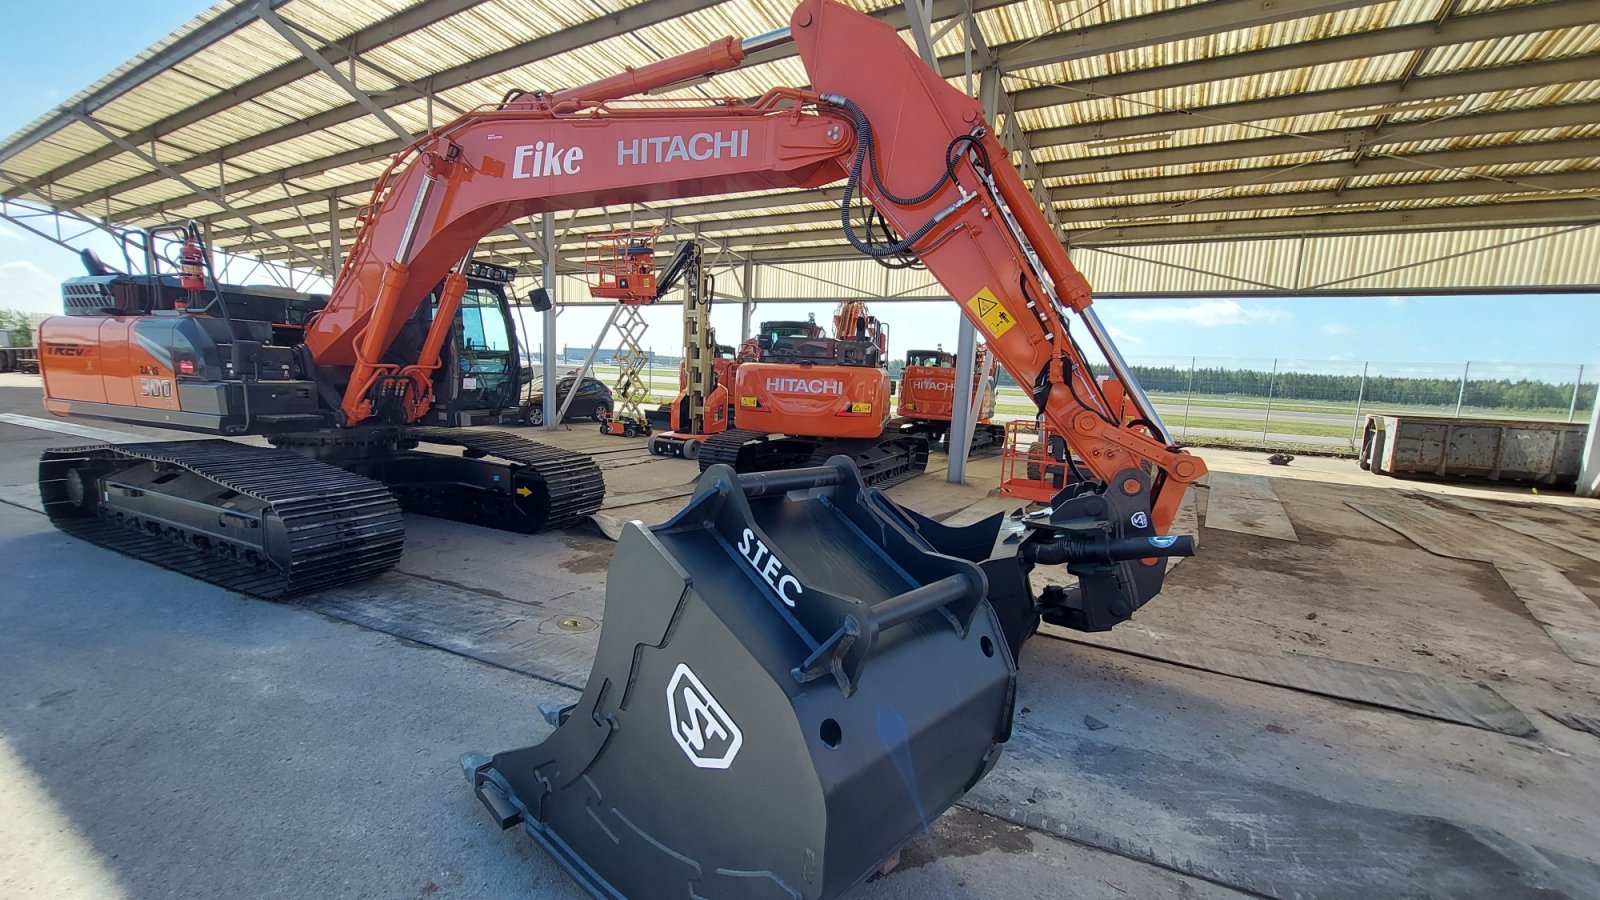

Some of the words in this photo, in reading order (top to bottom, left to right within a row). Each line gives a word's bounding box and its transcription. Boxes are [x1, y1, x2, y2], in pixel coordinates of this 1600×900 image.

[512, 140, 584, 180] Eike
[617, 129, 749, 165] HITACHI
[140, 377, 172, 400] 300
[766, 377, 843, 395] HITACHI
[913, 381, 954, 391] HITACH
[737, 528, 803, 608] STEC
